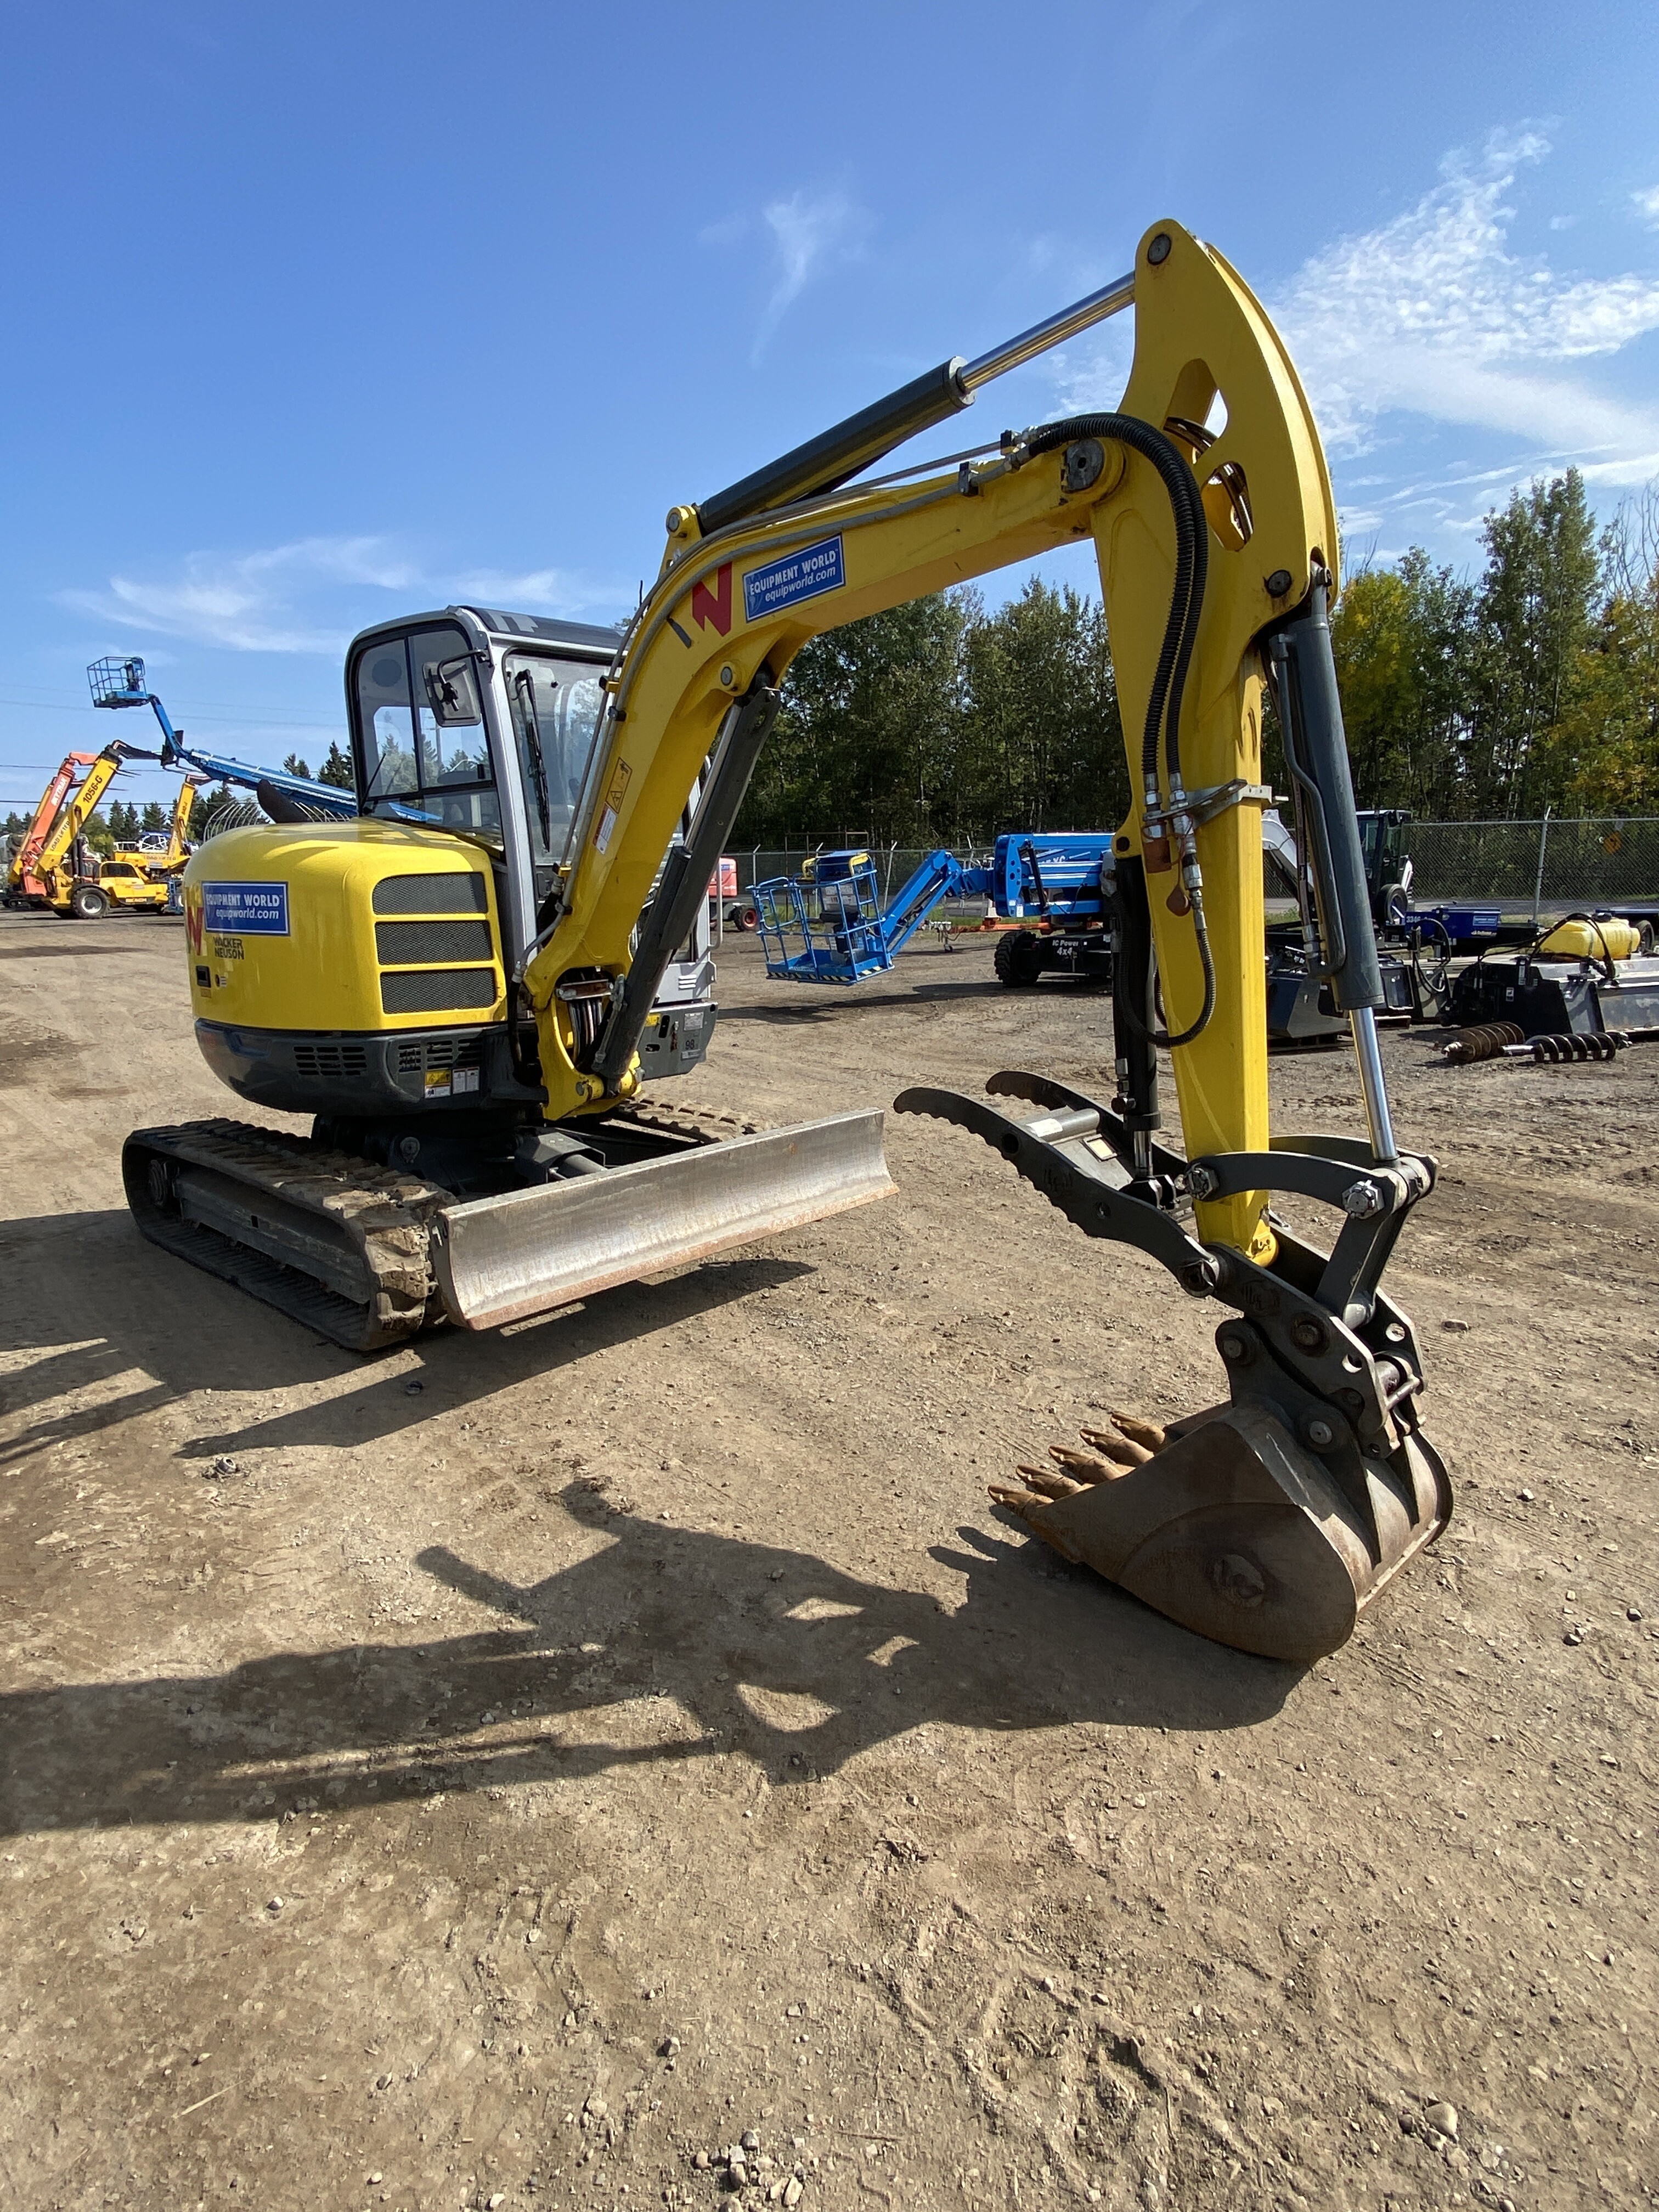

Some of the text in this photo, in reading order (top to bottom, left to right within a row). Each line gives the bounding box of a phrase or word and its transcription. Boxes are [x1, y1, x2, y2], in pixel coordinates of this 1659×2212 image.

[749, 550, 836, 596] EQUIPMENT WORLD
[765, 566, 836, 602] equipworld.com
[206, 894, 280, 907] EQUIPMENT WORLD
[216, 907, 279, 921] equipworld.com
[213, 936, 243, 949] WACKER
[215, 946, 245, 960] NEUSON
[1057, 947, 1073, 956] 4x4
